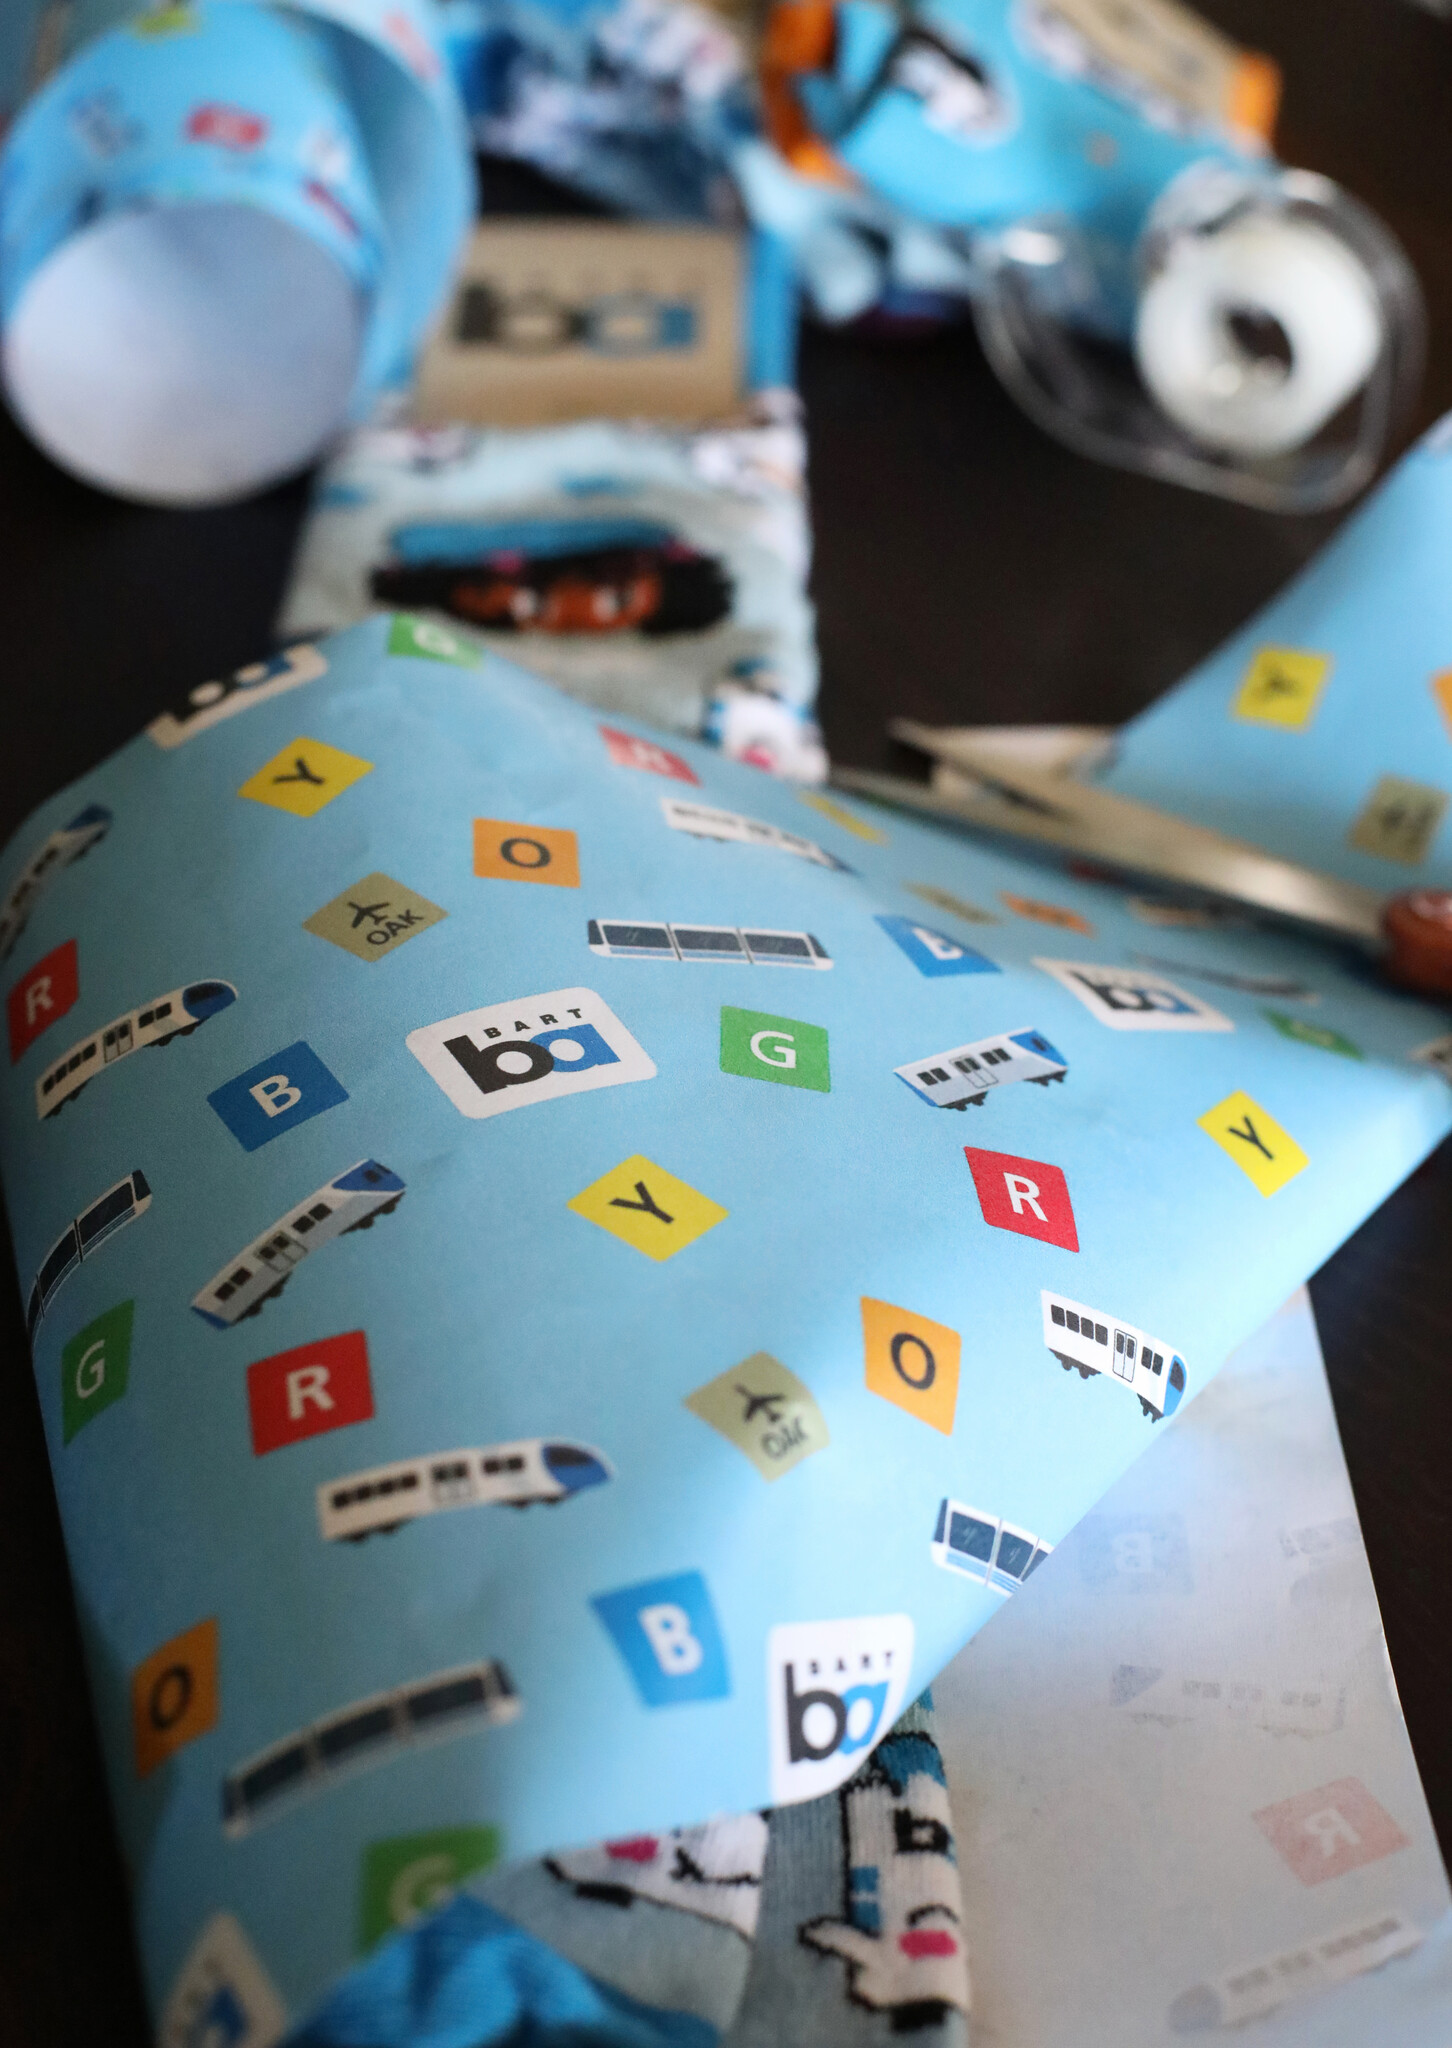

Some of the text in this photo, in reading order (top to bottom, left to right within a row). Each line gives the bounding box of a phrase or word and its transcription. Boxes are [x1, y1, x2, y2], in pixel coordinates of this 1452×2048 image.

[272, 757, 325, 785] Y
[500, 837, 552, 869] O
[366, 908, 424, 946] OAK
[24, 974, 53, 1027] R
[483, 1007, 583, 1039] BART
[749, 1030, 797, 1070] G
[249, 1074, 302, 1118] B
[1228, 1115, 1274, 1161] Y
[608, 1181, 674, 1224] Y
[1003, 1172, 1049, 1222] R
[76, 1339, 106, 1399] G
[891, 1332, 936, 1391] O
[286, 1364, 336, 1420] R
[639, 1602, 702, 1677] B
[149, 1664, 193, 1733] O
